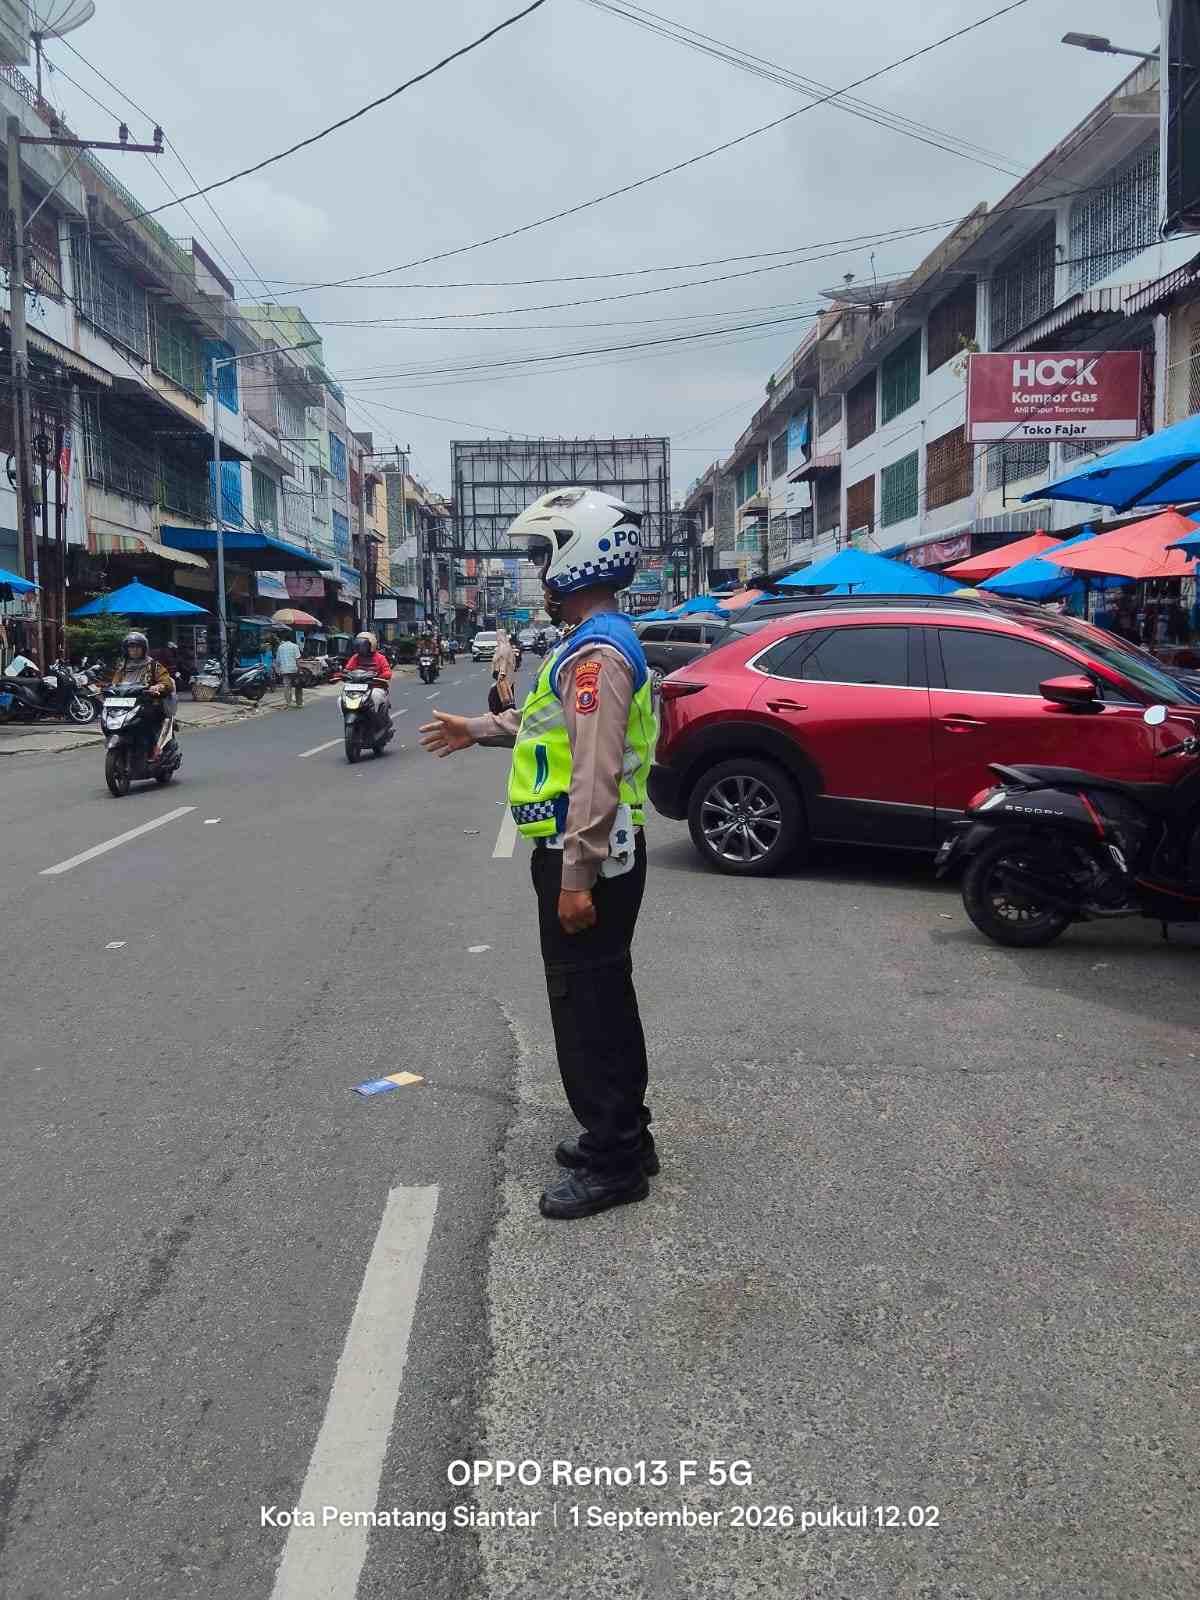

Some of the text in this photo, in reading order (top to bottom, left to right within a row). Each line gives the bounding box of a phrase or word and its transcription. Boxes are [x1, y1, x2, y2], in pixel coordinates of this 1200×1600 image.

[1013, 359, 1098, 386] HOCK
[1011, 391, 1098, 405] Kompor Gas
[1022, 424, 1087, 436] Toko Fajar
[614, 530, 640, 547] PO
